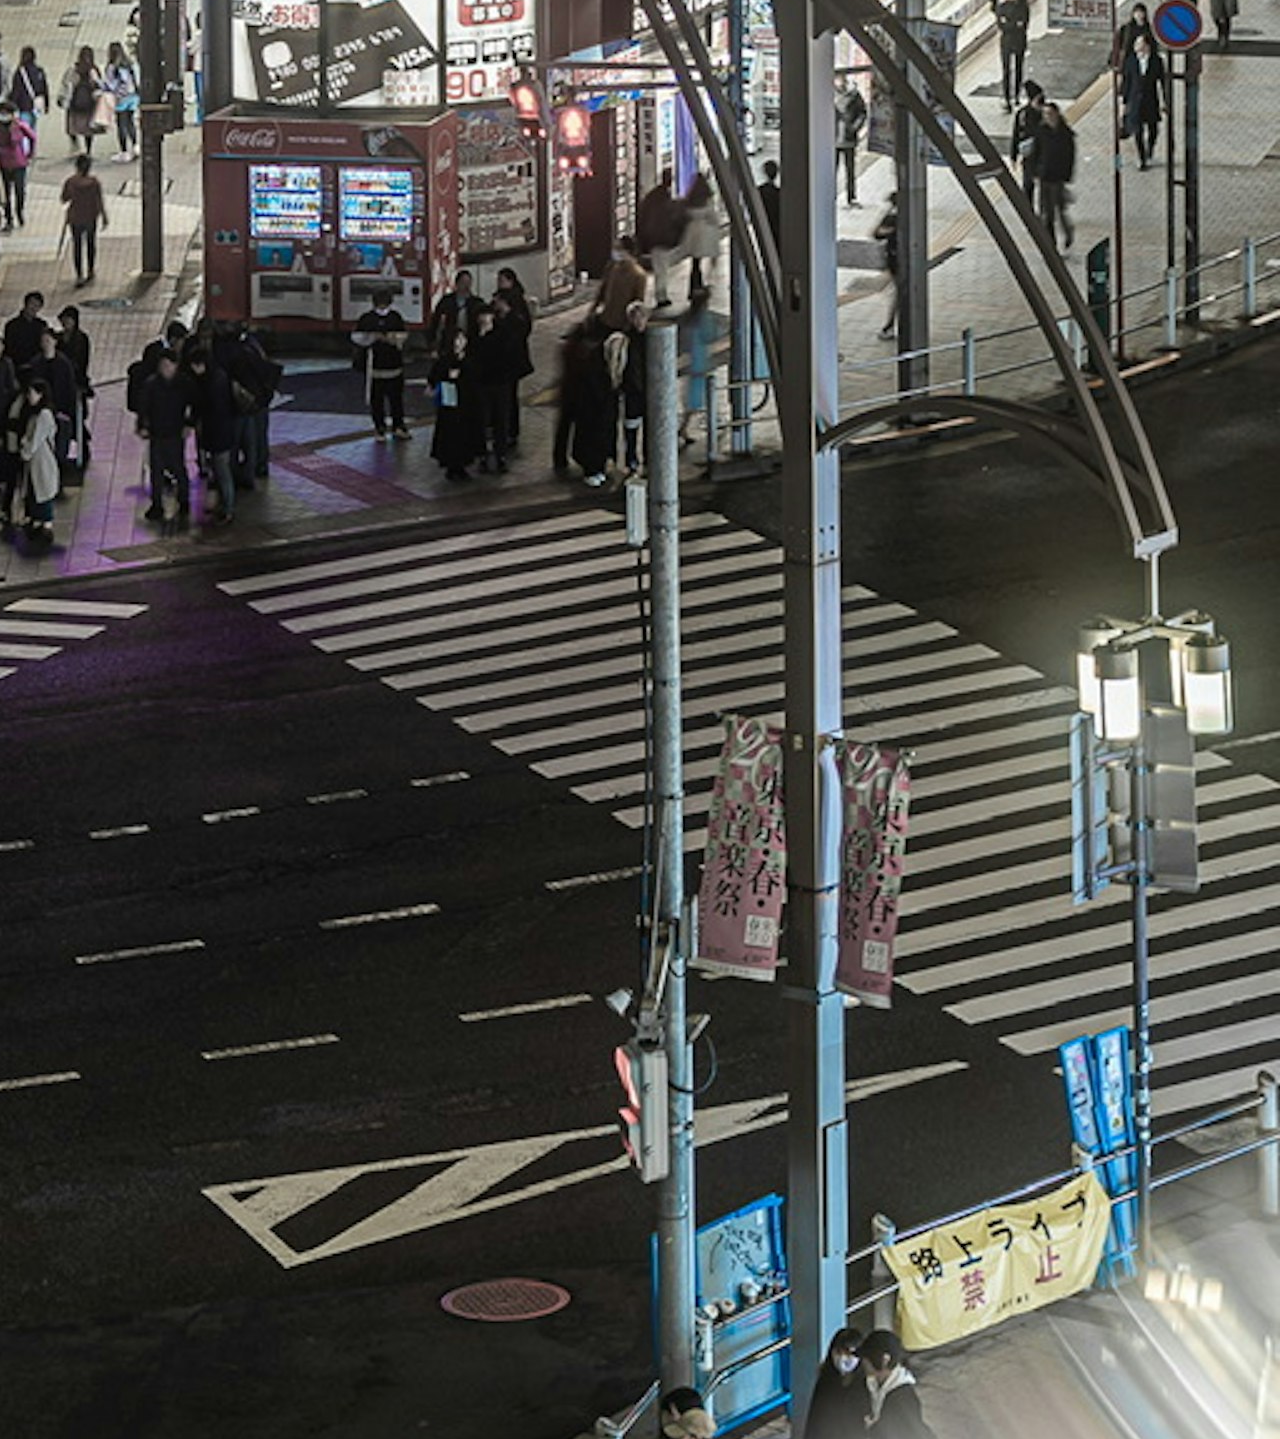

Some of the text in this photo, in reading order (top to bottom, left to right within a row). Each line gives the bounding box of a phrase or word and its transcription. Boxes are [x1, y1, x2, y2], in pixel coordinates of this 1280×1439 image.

[389, 45, 434, 70] VISA
[713, 803, 751, 917] 音楽祭
[909, 1192, 1087, 1285] 路上ライブ
[961, 1246, 1063, 1312] 禁止
